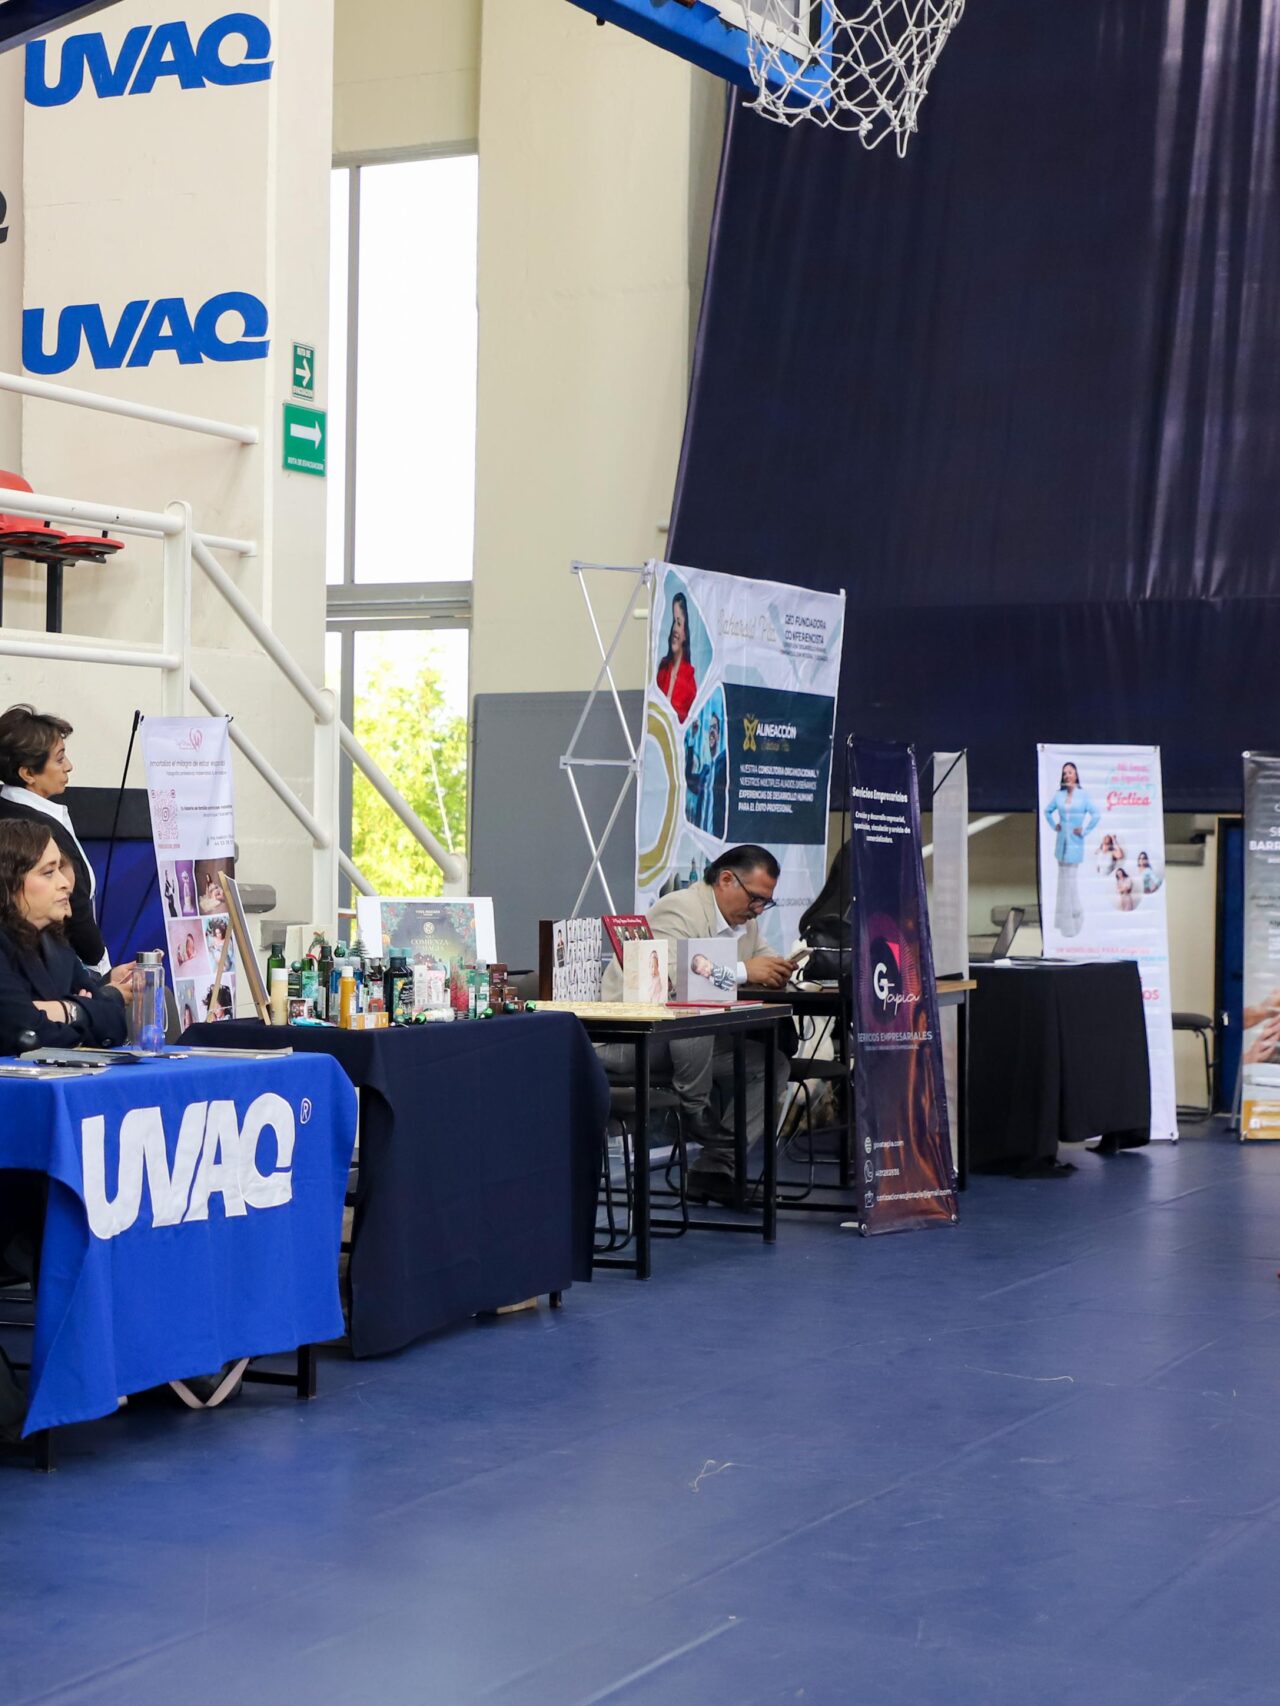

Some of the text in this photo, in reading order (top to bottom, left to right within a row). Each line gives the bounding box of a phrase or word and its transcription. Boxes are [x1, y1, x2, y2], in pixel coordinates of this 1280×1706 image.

[24, 12, 274, 107] UVAQ
[22, 291, 271, 375] UVAQ
[81, 1092, 296, 1240] UVAQ
